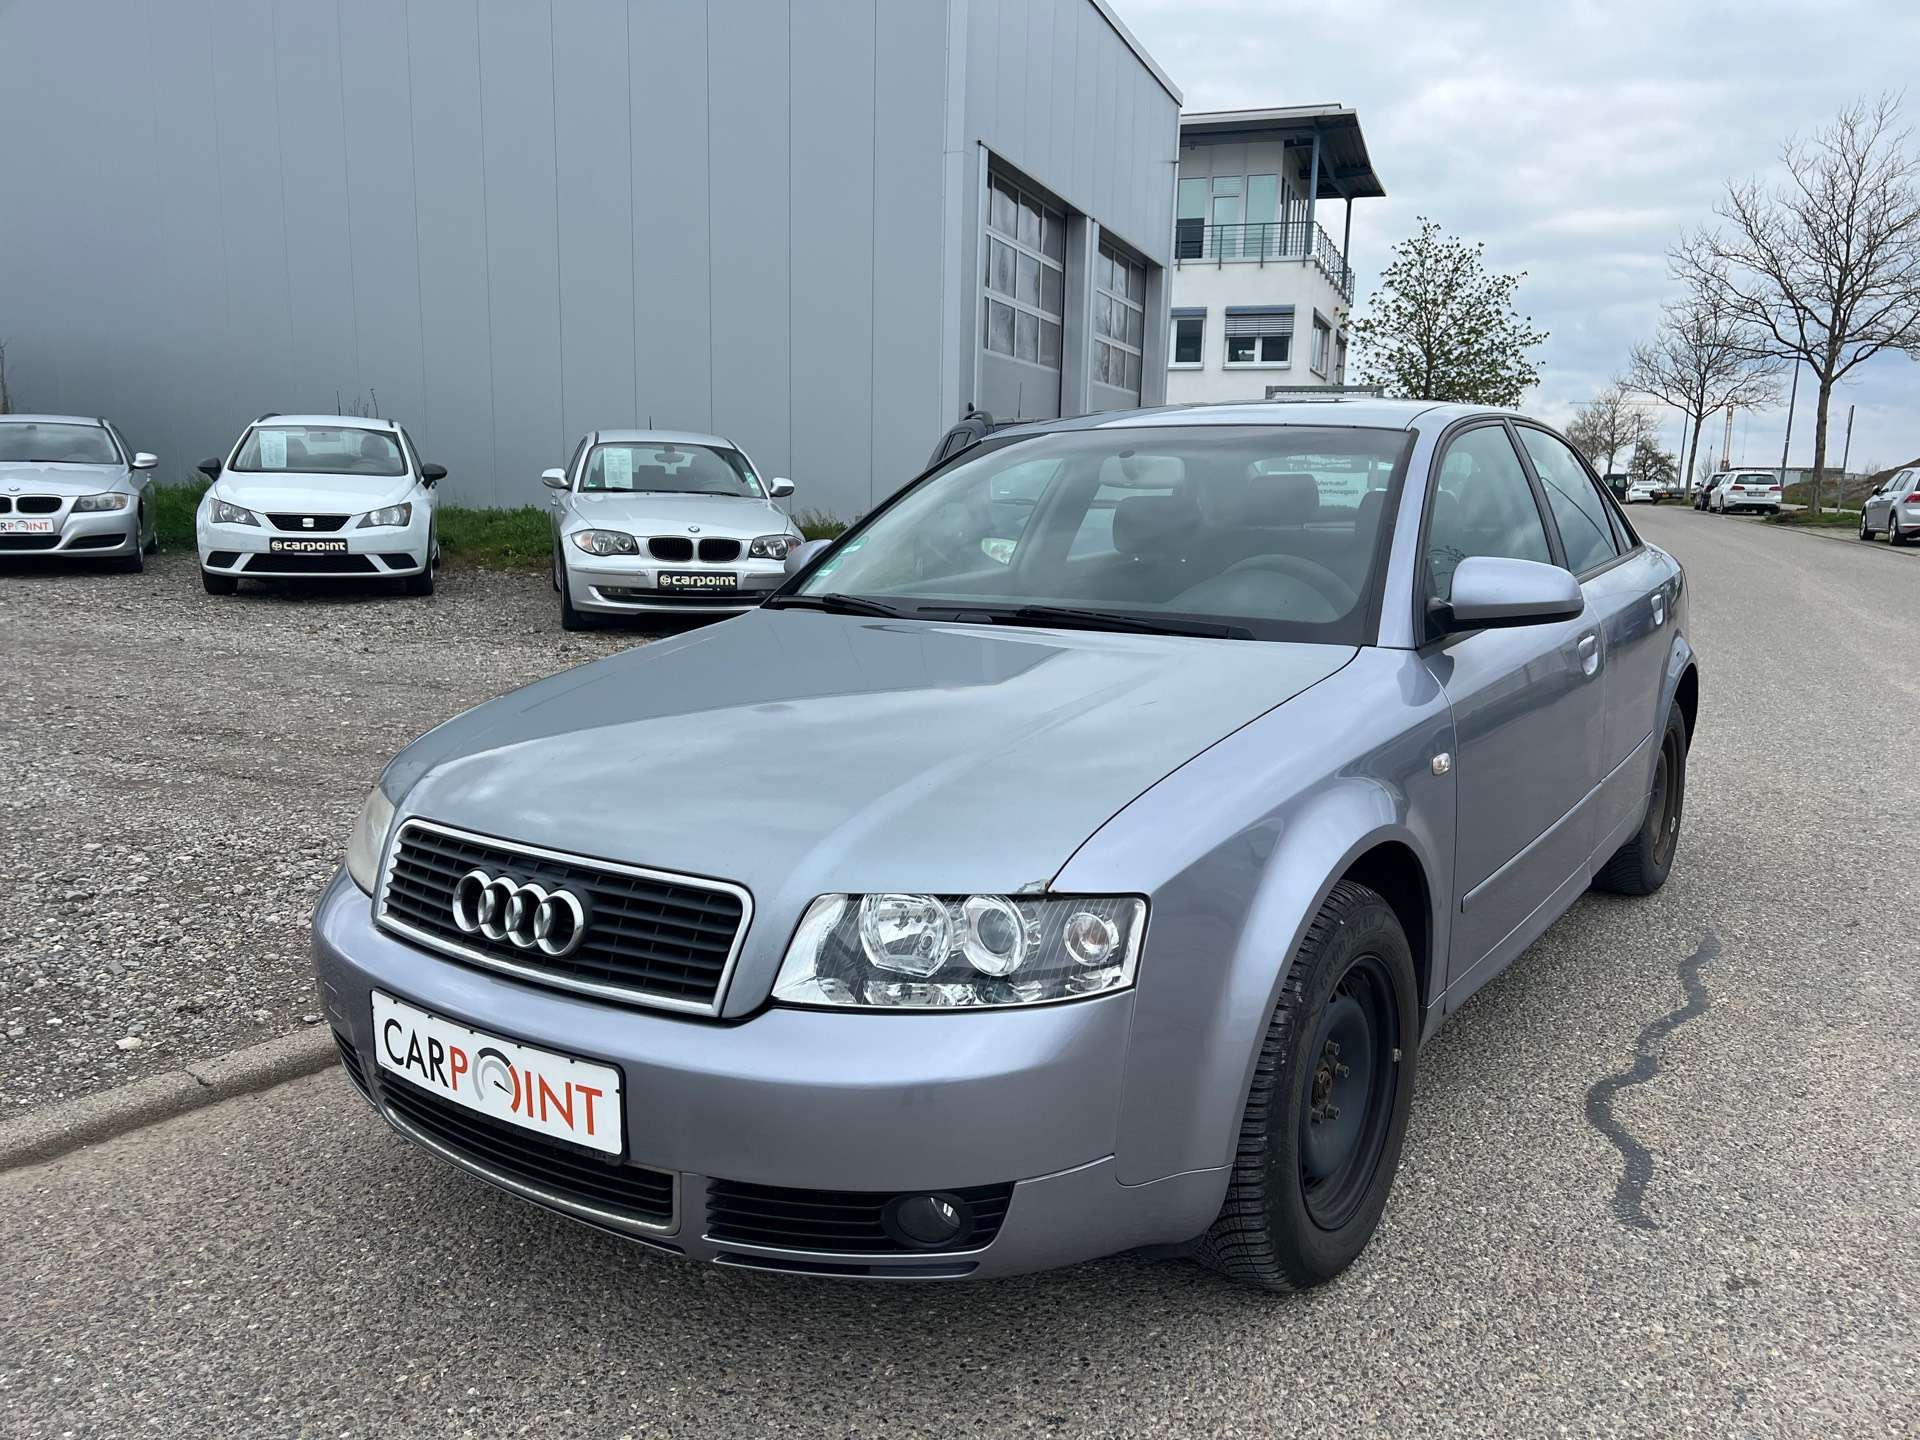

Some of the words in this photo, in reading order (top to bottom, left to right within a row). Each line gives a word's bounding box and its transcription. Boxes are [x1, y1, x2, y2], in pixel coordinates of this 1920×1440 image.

[283, 541, 346, 551] carpoint
[672, 575, 736, 587] carpoint
[383, 1017, 603, 1137] CARPOINT
